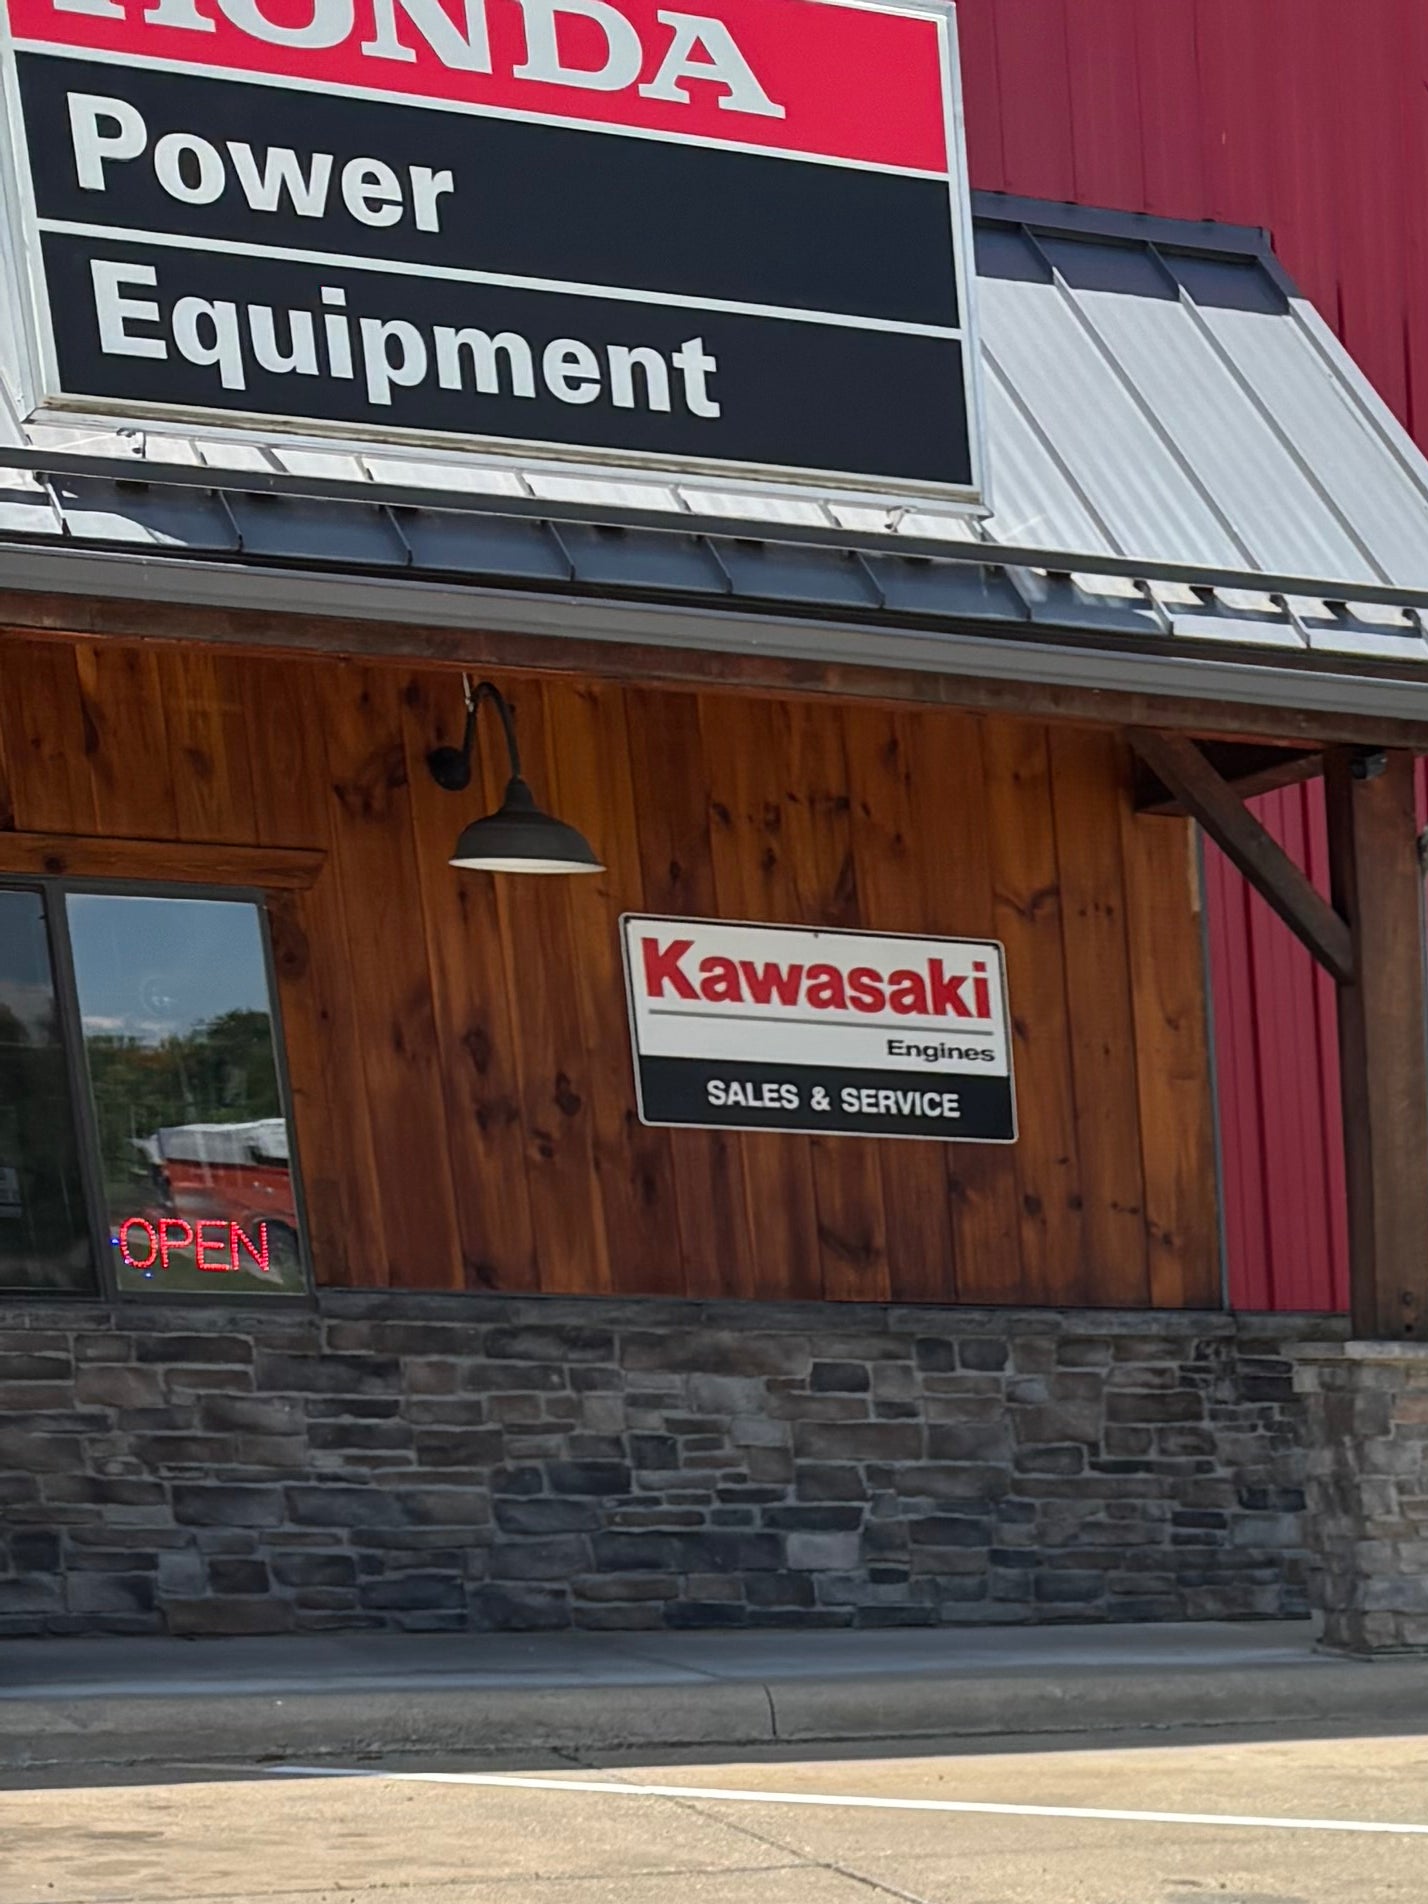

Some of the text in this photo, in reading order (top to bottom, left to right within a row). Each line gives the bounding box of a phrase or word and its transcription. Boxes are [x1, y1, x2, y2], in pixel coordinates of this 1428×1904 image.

[55, 0, 786, 119] NDA
[66, 91, 454, 235] Power
[89, 258, 721, 420] Equipment
[641, 936, 992, 1020] Kawasaki
[886, 1038, 996, 1064] Engines
[706, 1079, 962, 1119] SALES & SERVICE
[119, 1217, 270, 1272] OPEN
